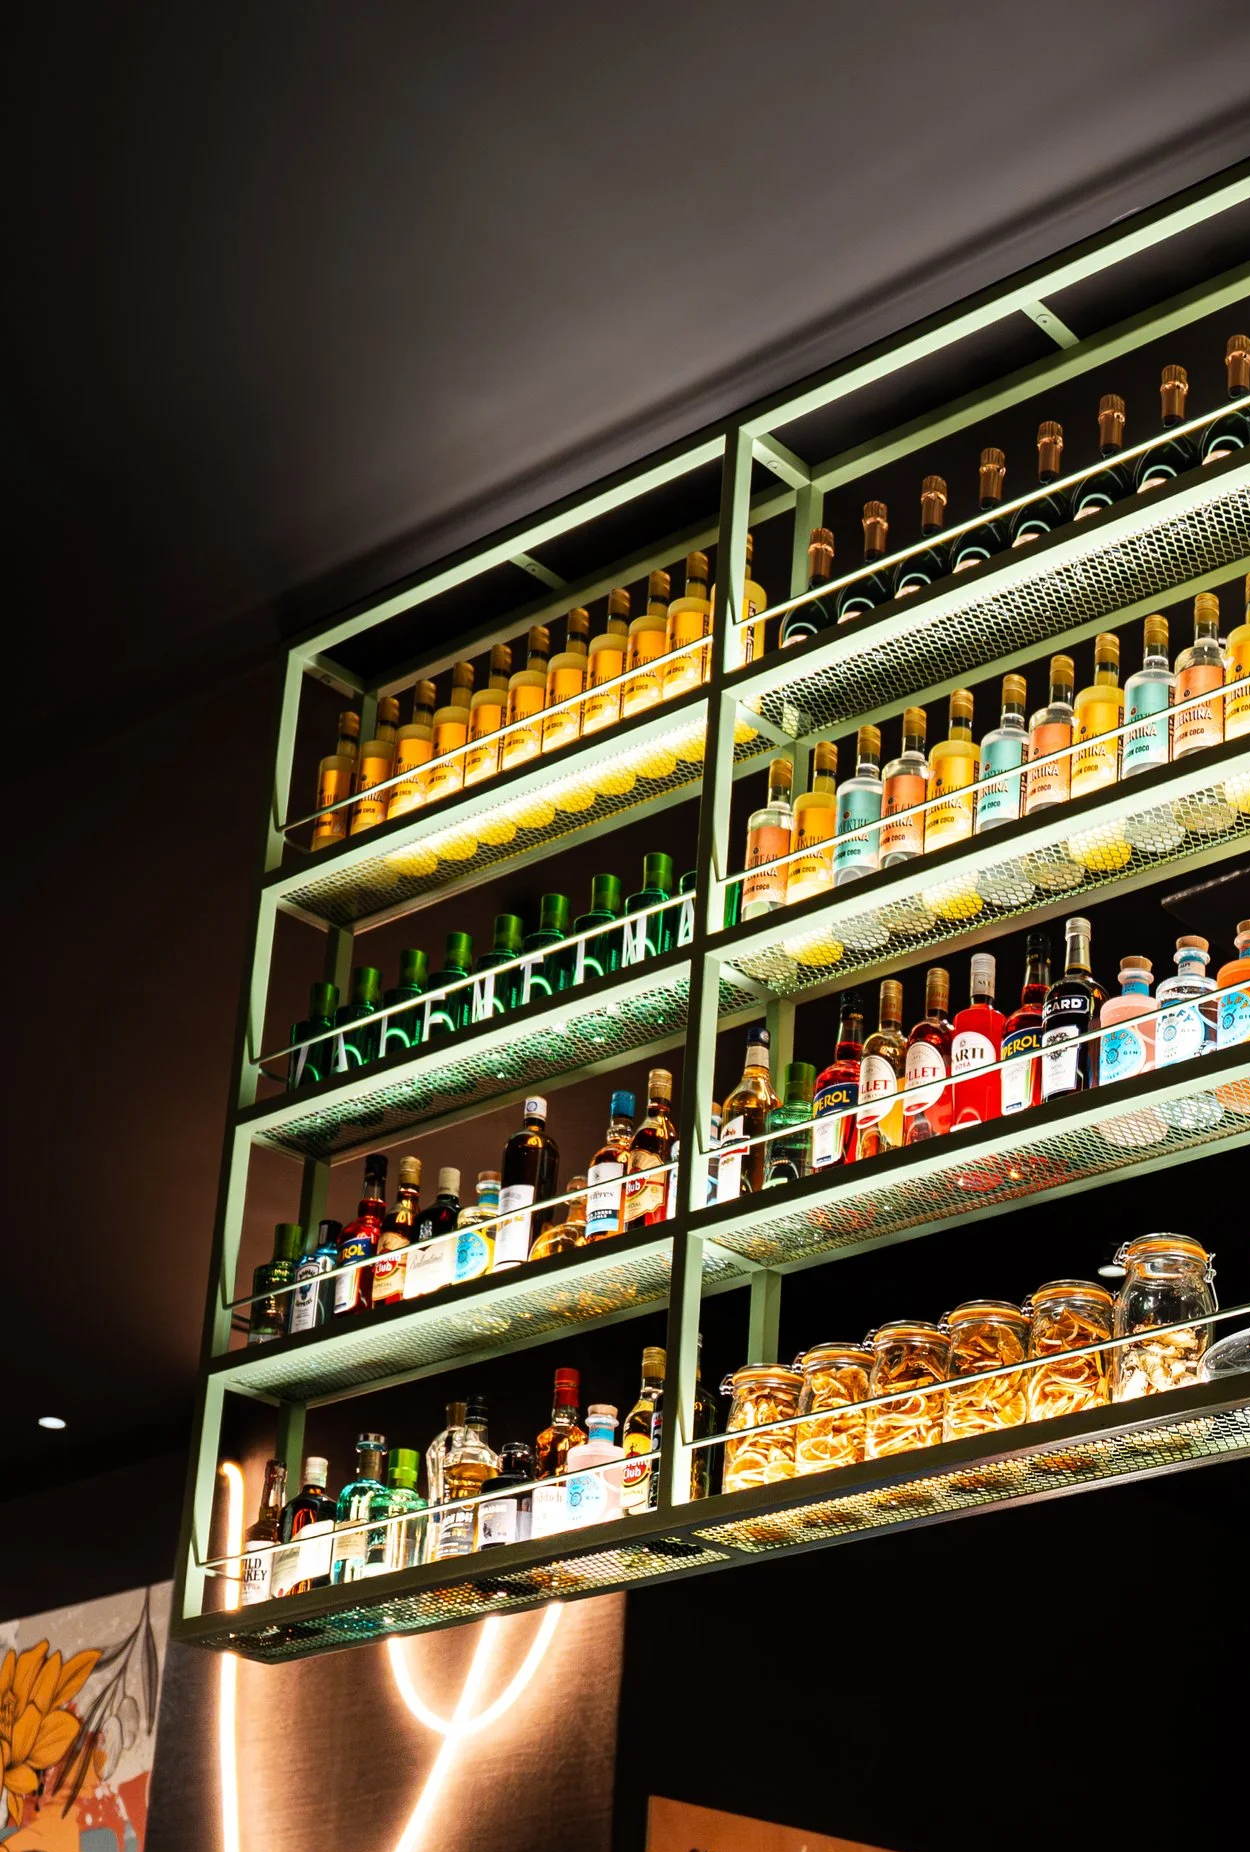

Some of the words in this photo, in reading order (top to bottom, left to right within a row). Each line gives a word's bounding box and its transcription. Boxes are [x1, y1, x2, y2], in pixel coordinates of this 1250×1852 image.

[1189, 727, 1205, 736] COCO
[1135, 745, 1149, 754] COCO
[1037, 783, 1052, 792] COCO
[987, 800, 1001, 809] COCO
[940, 816, 955, 824] COCO
